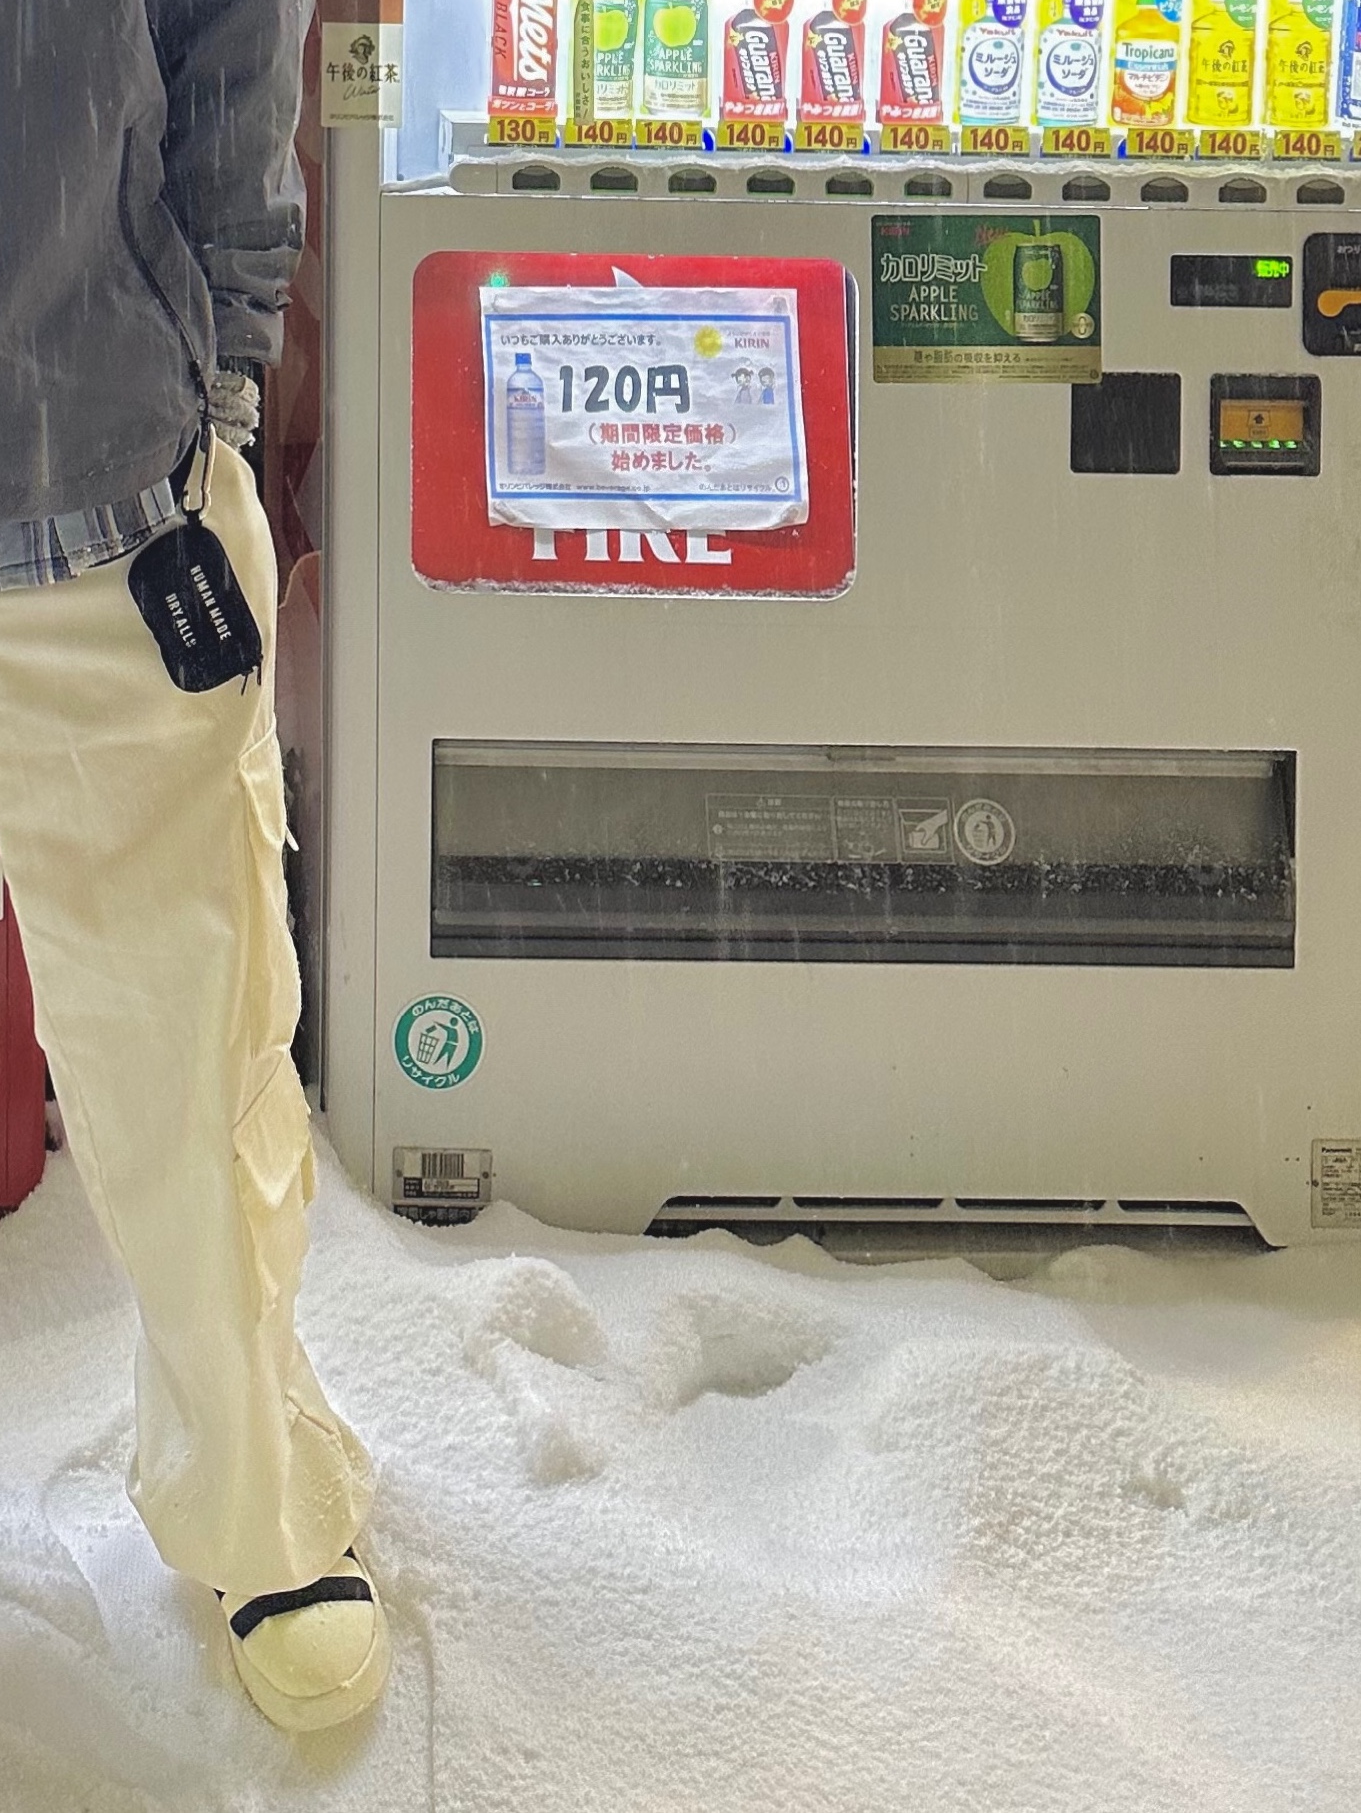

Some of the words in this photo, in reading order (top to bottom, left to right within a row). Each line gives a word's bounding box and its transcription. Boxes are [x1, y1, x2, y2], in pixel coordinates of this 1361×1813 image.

[495, 1, 508, 59] BLACK
[659, 47, 693, 60] APPLE
[1124, 43, 1174, 62] Tropicana
[326, 61, 400, 83] 午後の紅茶
[650, 60, 702, 73] SPARKLING
[497, 120, 549, 142] 130円
[577, 121, 627, 144] 140円
[644, 122, 697, 144] 140円
[726, 124, 779, 147] 140円
[804, 124, 857, 147] 140円
[890, 127, 943, 150] 140円
[971, 129, 1023, 151] 140円
[1052, 129, 1105, 152] 140円
[1136, 131, 1188, 153] 140円
[1209, 133, 1260, 155] 140円
[1282, 134, 1335, 156] 140円
[881, 253, 988, 282] カロリミット
[909, 285, 958, 302] APPLE
[890, 304, 978, 321] SPARKLING
[500, 332, 662, 348] いつもご購入ありがとうございます。
[734, 336, 771, 349] KIRIN
[559, 364, 691, 414] 120円
[611, 452, 714, 473] 始めました。
[190, 565, 216, 607] HUMAN
[209, 607, 232, 640] MADE
[412, 999, 479, 1034] のんだあとは
[402, 1056, 460, 1087] リサイクル
